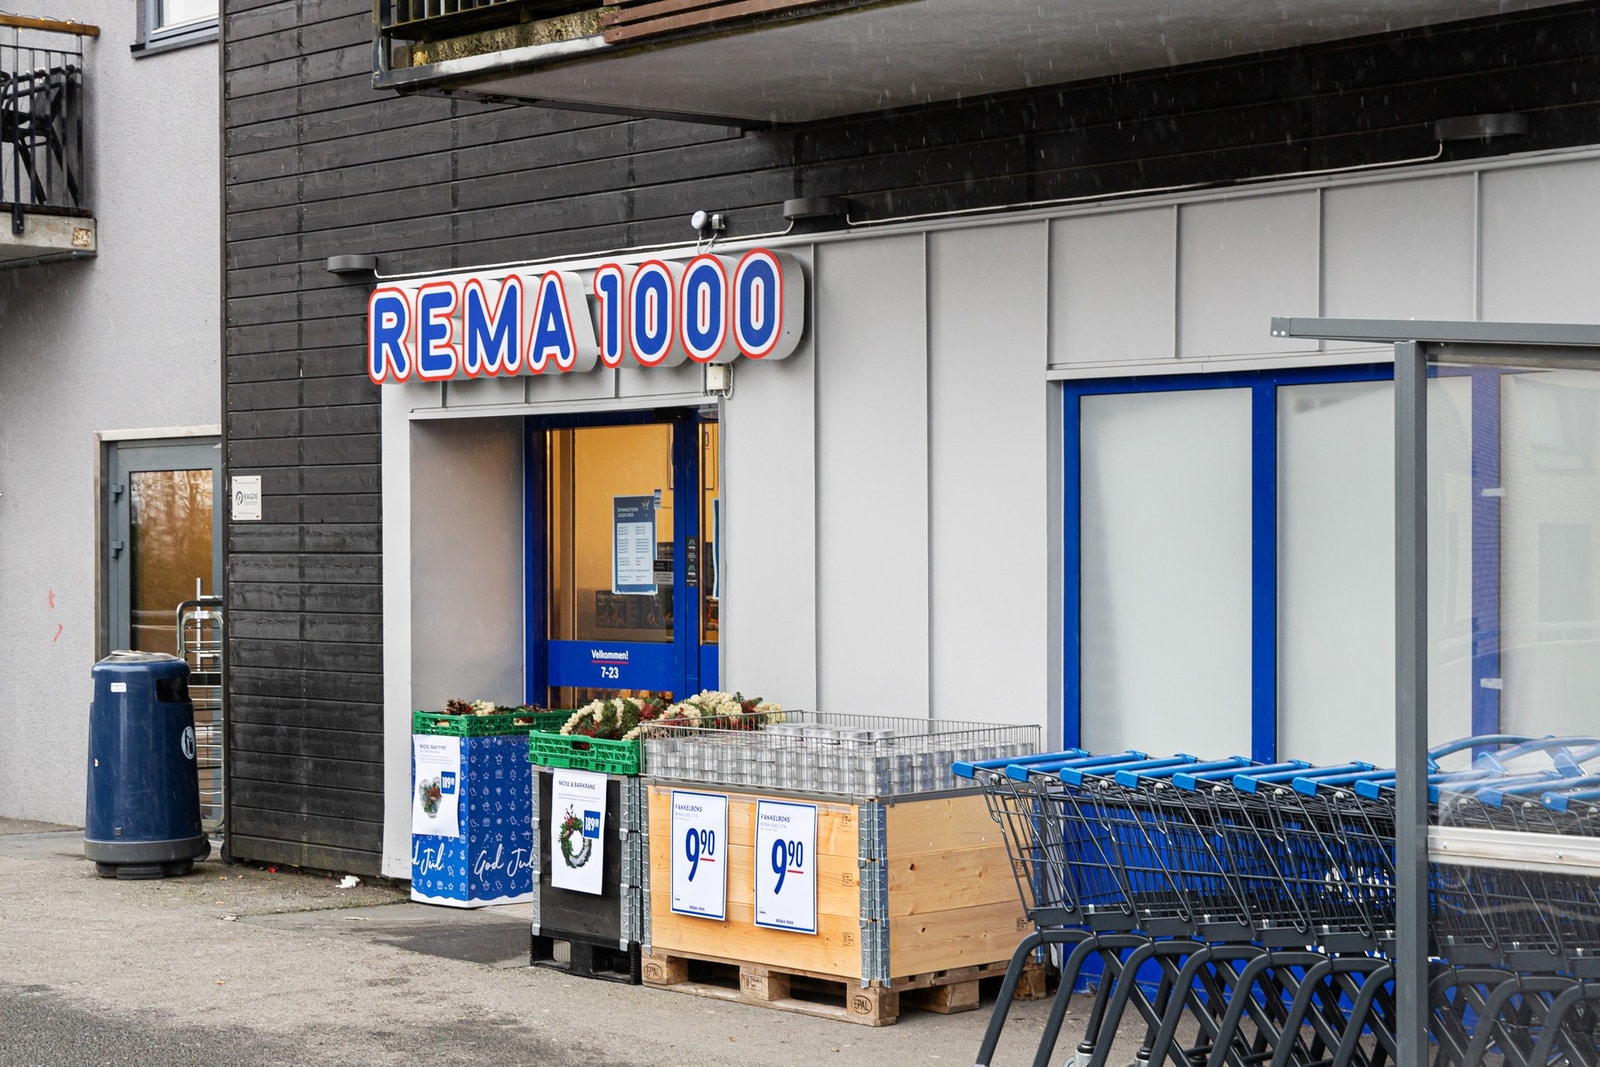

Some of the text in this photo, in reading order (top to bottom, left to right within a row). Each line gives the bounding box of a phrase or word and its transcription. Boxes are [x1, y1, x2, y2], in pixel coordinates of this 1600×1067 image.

[368, 247, 784, 385] REMA 1000
[591, 649, 629, 660] Velkommen!
[601, 666, 619, 679] 7-23
[675, 804, 703, 812] FAKKELBOKS
[760, 814, 791, 823] FAKKELBOKS
[420, 842, 446, 876] Jul
[473, 843, 505, 882] God
[854, 999, 869, 1012] EPAL
